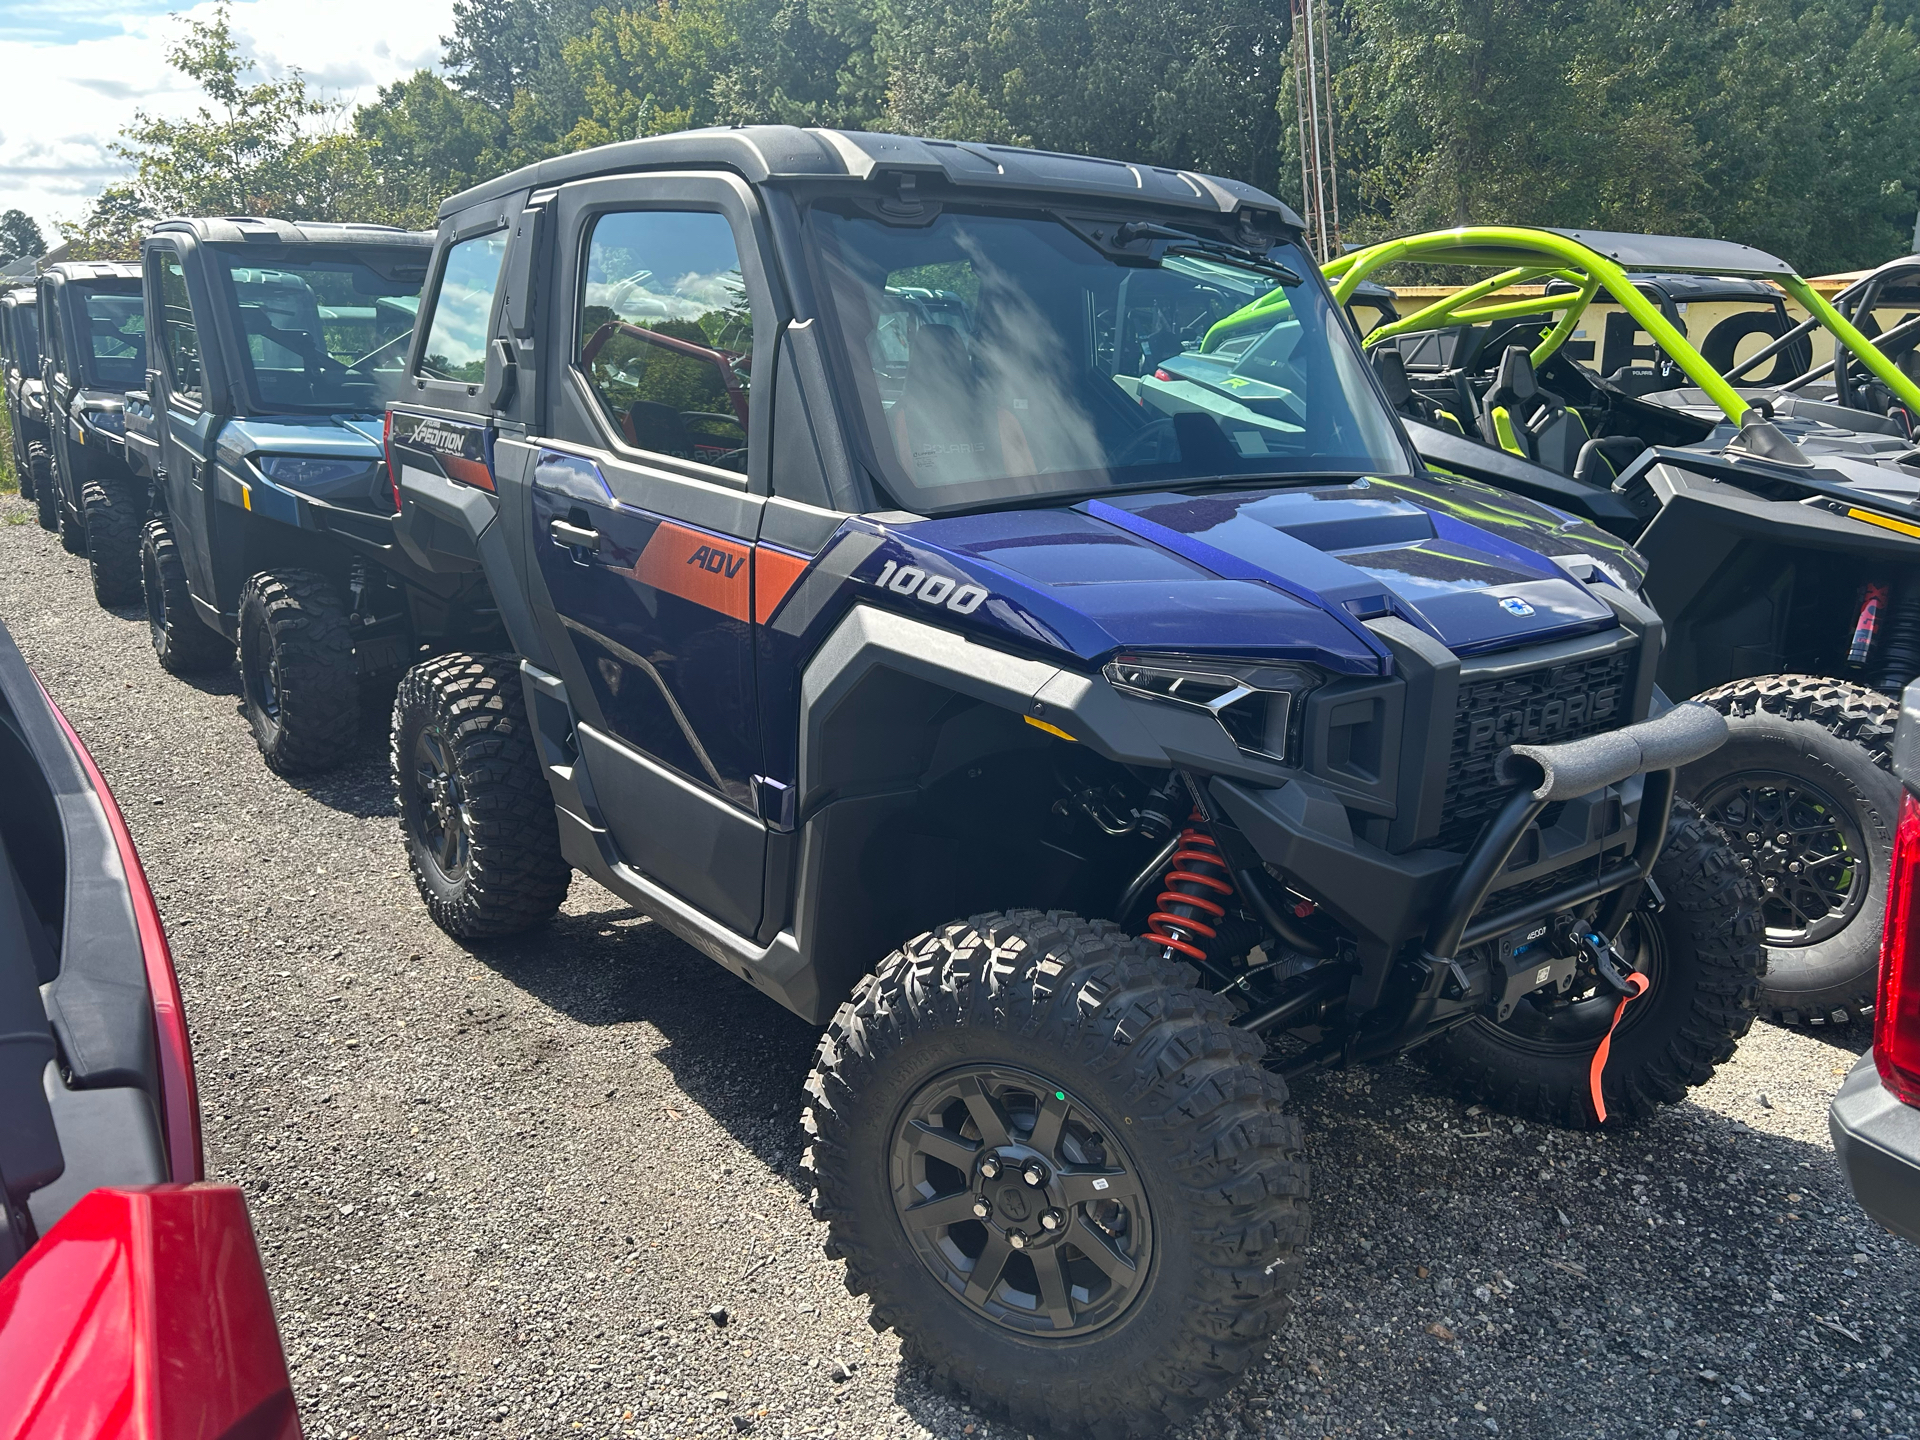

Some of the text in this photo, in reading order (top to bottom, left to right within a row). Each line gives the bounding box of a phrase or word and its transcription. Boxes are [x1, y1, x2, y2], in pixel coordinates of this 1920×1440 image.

[408, 420, 465, 451] XPEDITION
[923, 442, 985, 454] POLARIS
[686, 545, 746, 579] ADV
[874, 559, 989, 615] 1000
[1468, 685, 1616, 752] POLARIS
